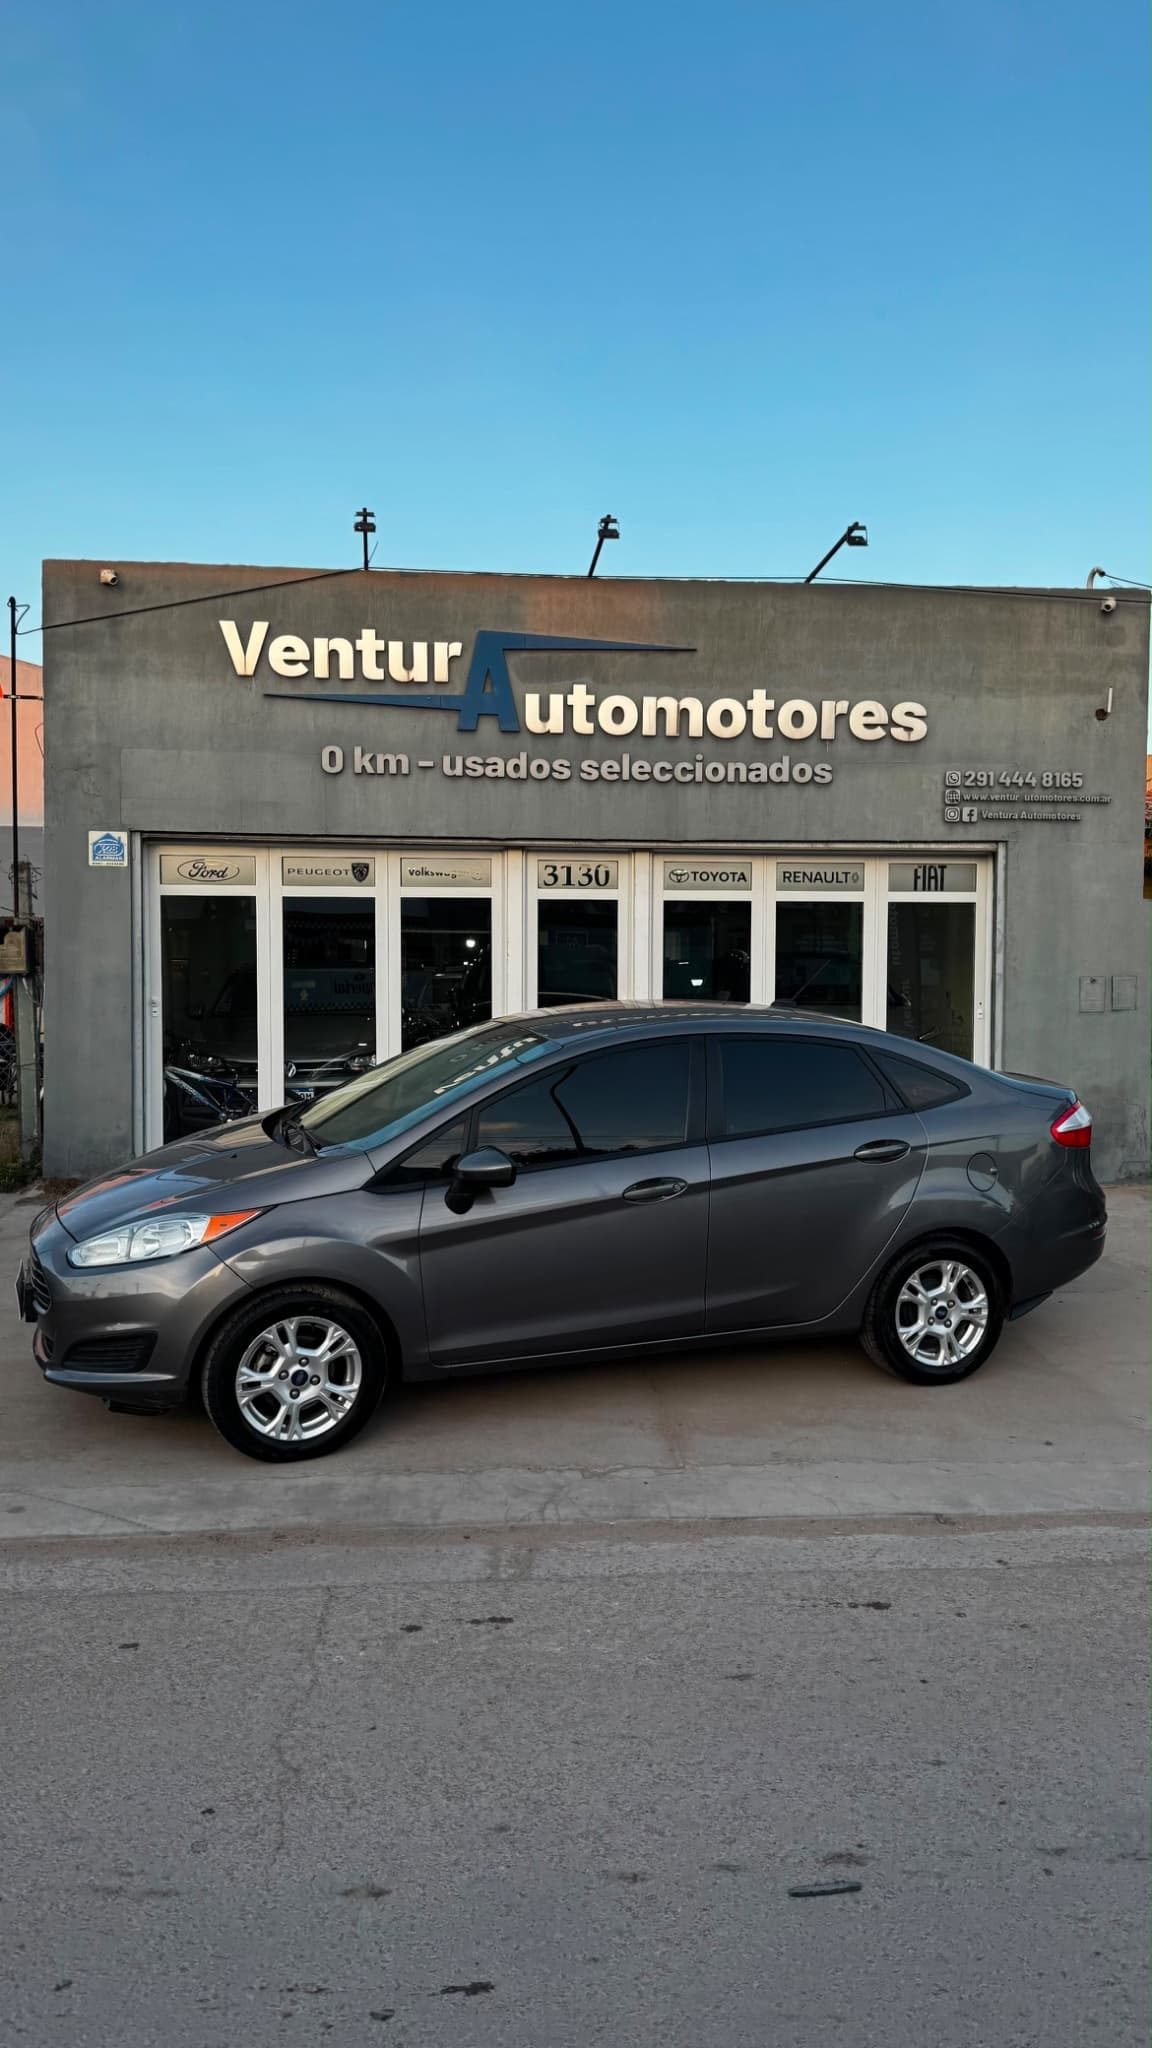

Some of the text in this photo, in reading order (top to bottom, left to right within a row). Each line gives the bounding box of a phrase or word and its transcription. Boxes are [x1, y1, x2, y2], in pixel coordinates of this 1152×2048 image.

[353, 746, 410, 775] km
[442, 751, 571, 780] usados
[579, 753, 833, 784] seleccionados
[963, 770, 1083, 788] 291 444 8165
[981, 809, 1081, 821] Ventura Automotores
[188, 859, 229, 879] Ford
[287, 867, 351, 877] PEUGEOT
[543, 864, 611, 887] 3130
[690, 871, 747, 883] TOYOTA
[782, 871, 851, 884] RENAULT
[913, 864, 948, 891] FIAT
